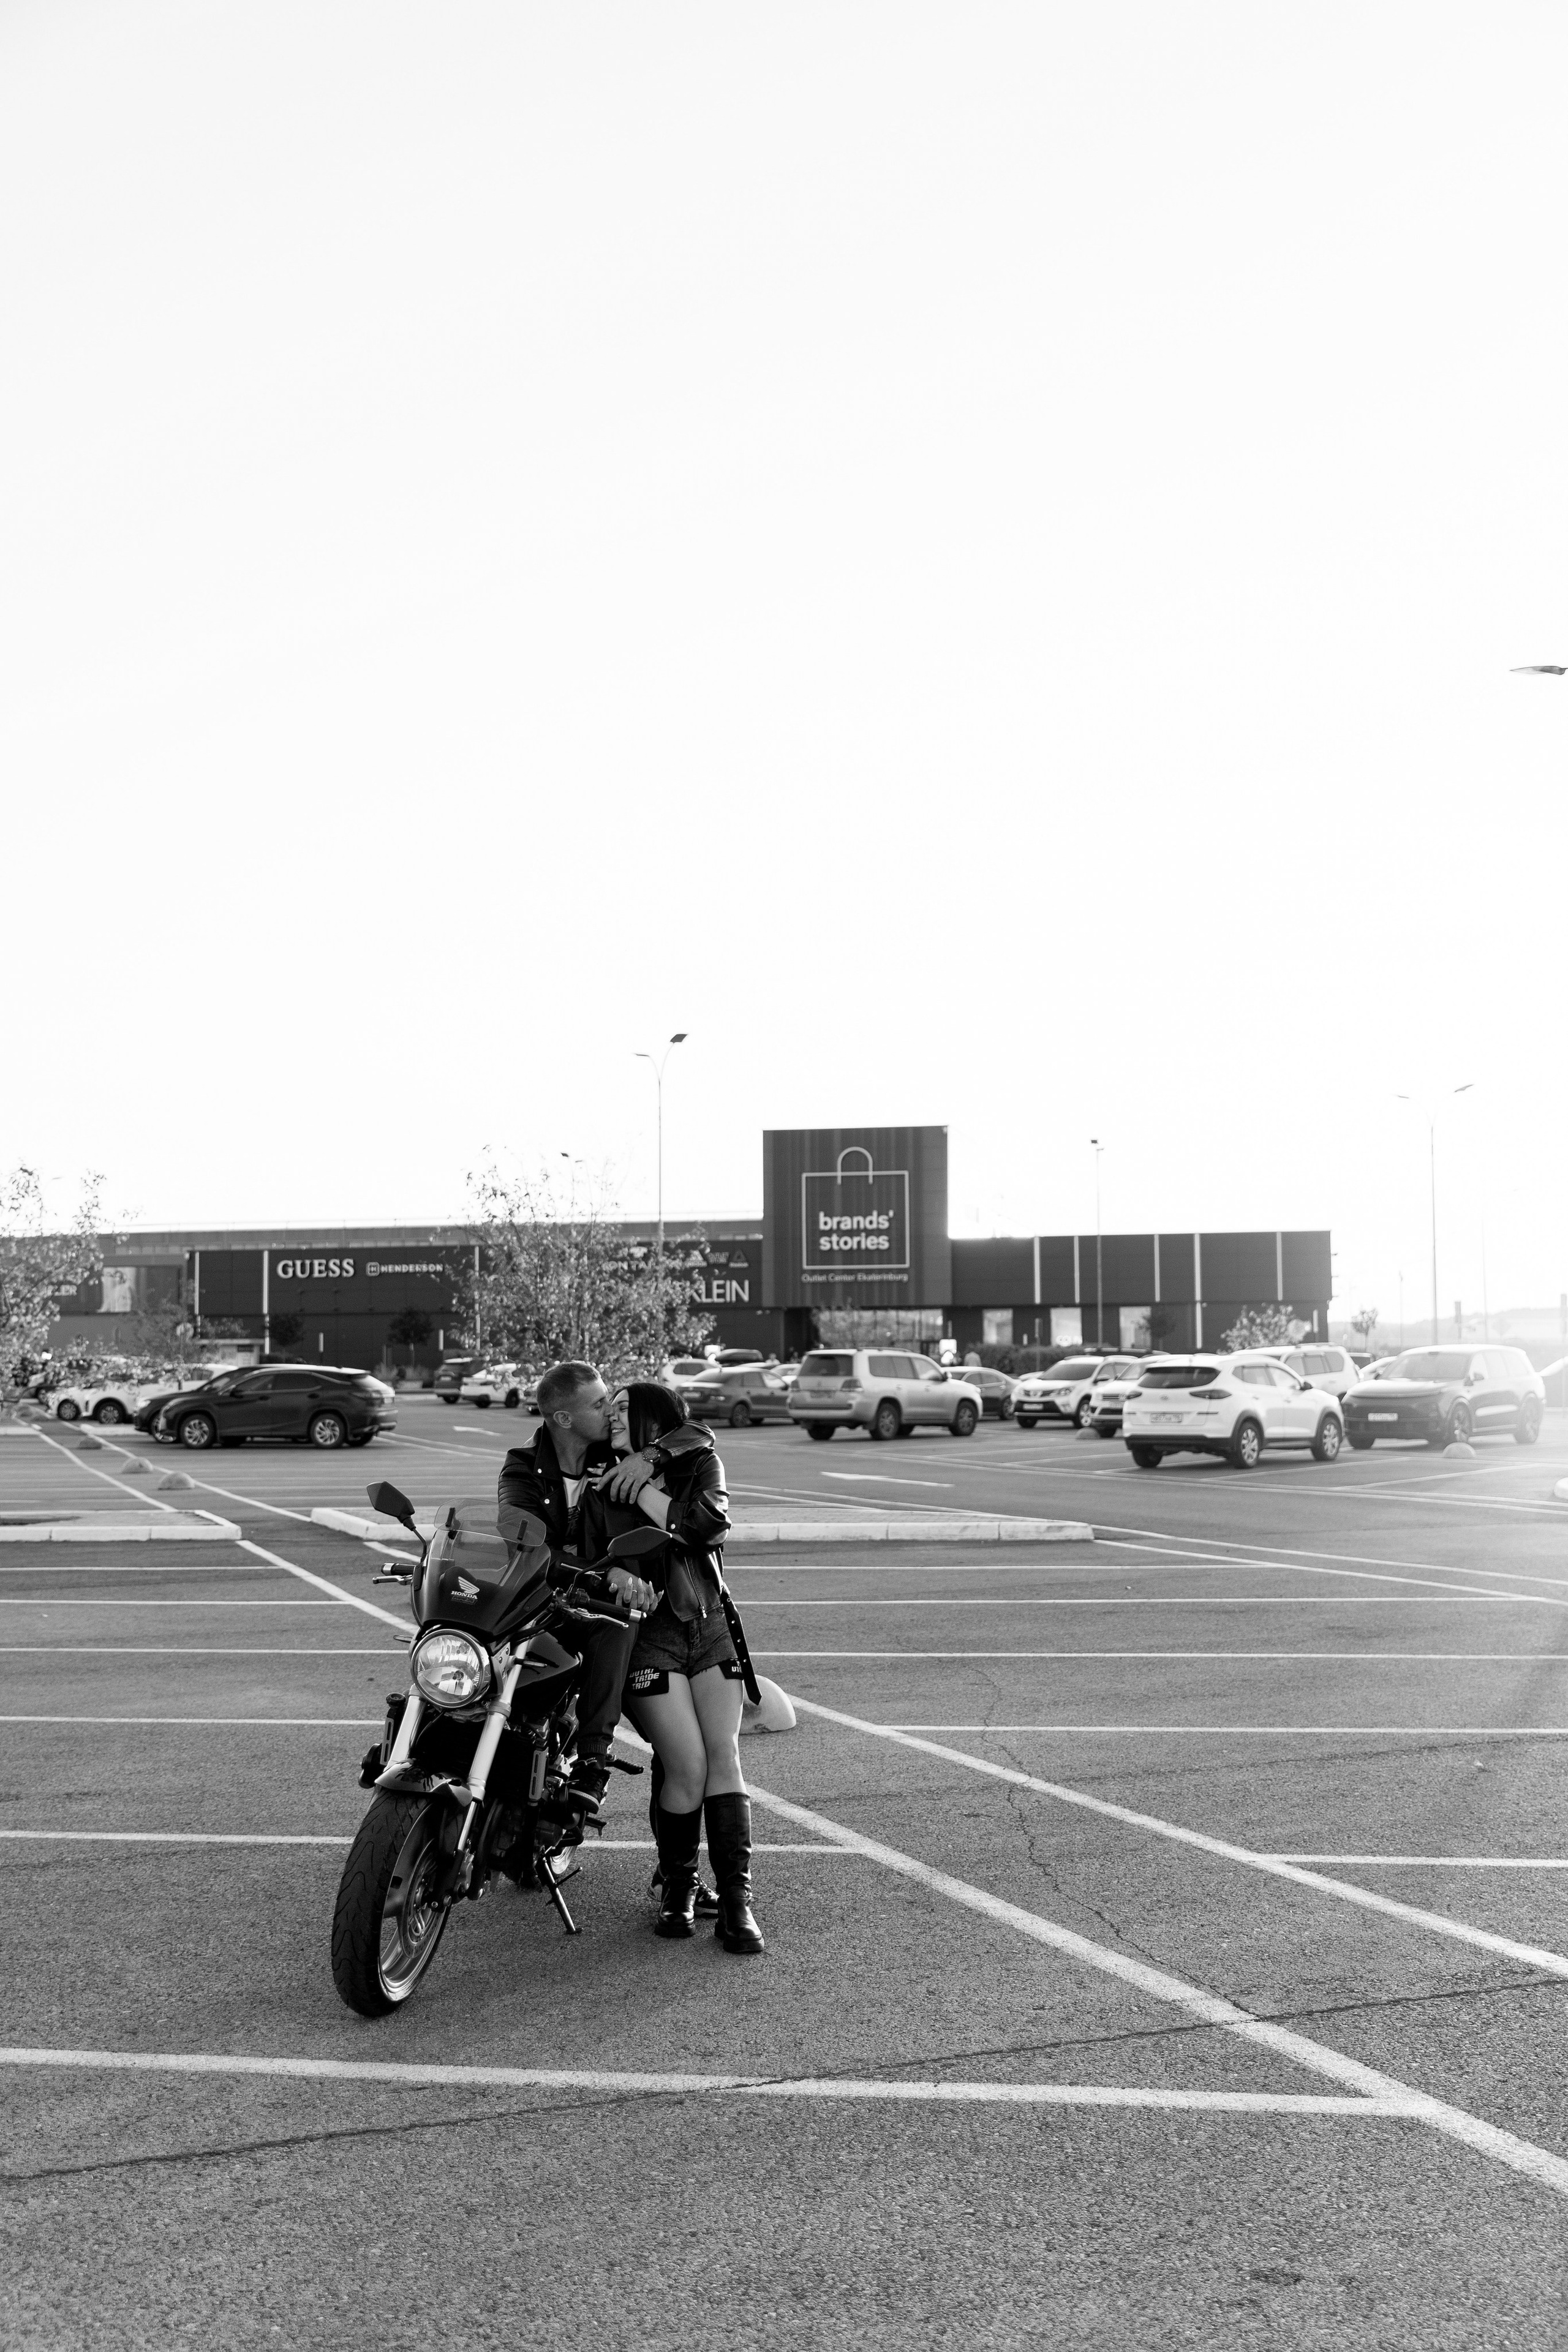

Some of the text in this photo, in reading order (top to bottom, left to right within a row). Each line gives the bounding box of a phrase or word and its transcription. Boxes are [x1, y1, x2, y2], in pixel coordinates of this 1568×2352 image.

[818, 1209, 894, 1231] brands'
[819, 1232, 890, 1251] stories
[276, 1258, 355, 1279] GUESS
[380, 1263, 443, 1273] HENDERSON
[801, 1273, 827, 1283] Outlet
[828, 1273, 856, 1283] Center
[451, 1591, 478, 1600] HONDA
[631, 1681, 651, 1690] TR!D
